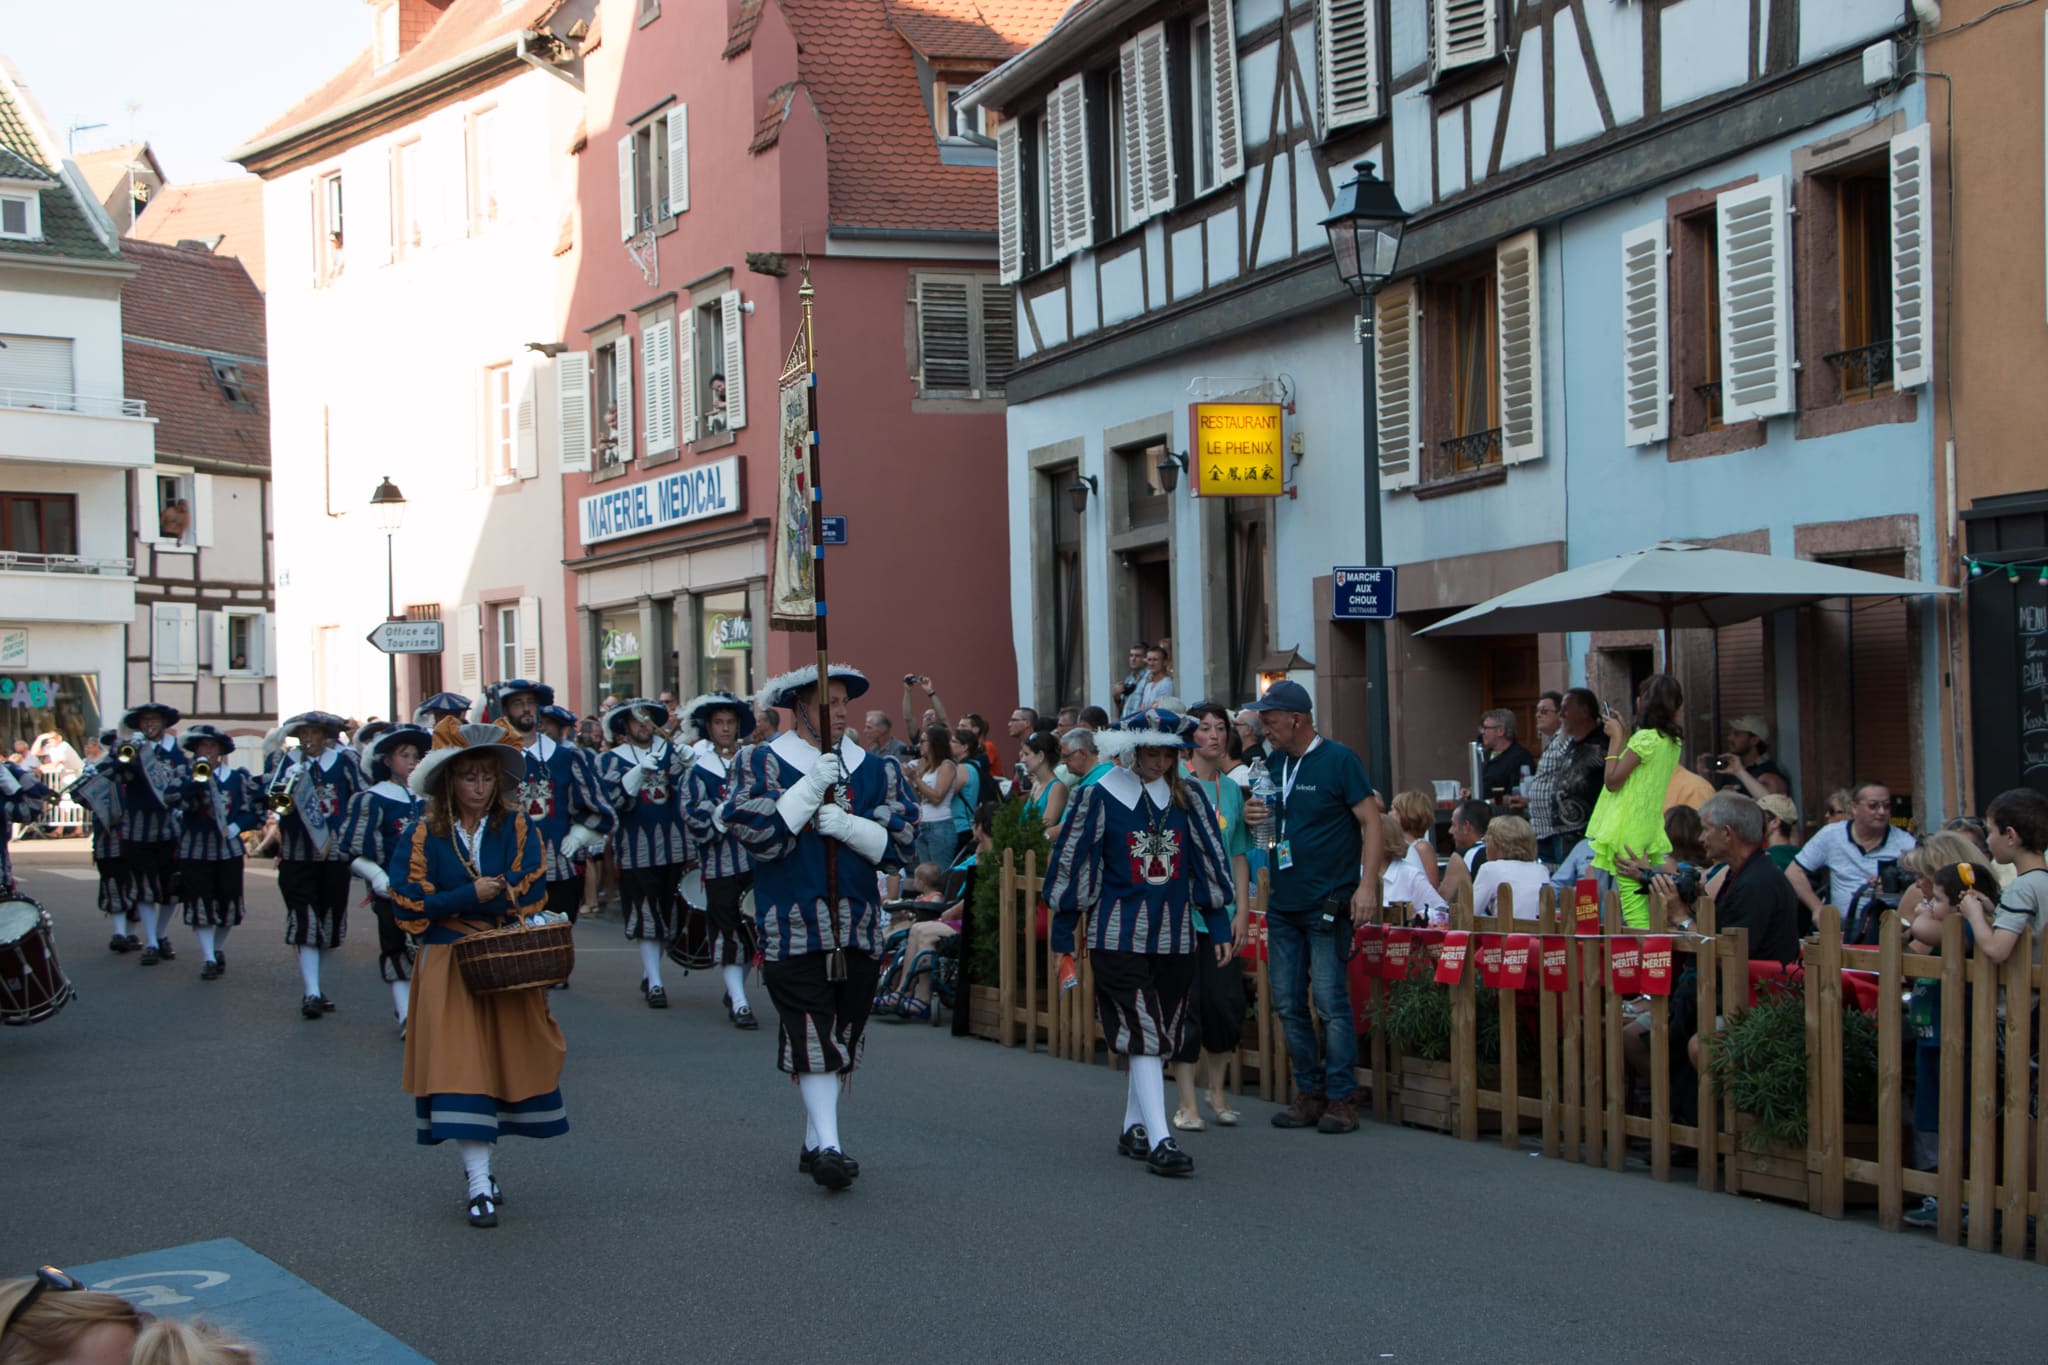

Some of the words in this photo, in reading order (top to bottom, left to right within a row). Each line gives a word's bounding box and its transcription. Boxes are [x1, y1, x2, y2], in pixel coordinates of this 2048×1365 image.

[1200, 415, 1278, 429] RESTAURANT
[1207, 441, 1223, 455] LE
[1226, 441, 1274, 455] PHENIX
[587, 485, 653, 539] MATERIEL
[658, 465, 726, 522] MEDICAL
[1346, 571, 1381, 582] MARCHÉ
[1355, 584, 1372, 593] AUX
[1349, 596, 1378, 605] CHOUX
[385, 627, 418, 636] Office
[423, 626, 436, 635] du
[387, 639, 436, 648] Tourisme
